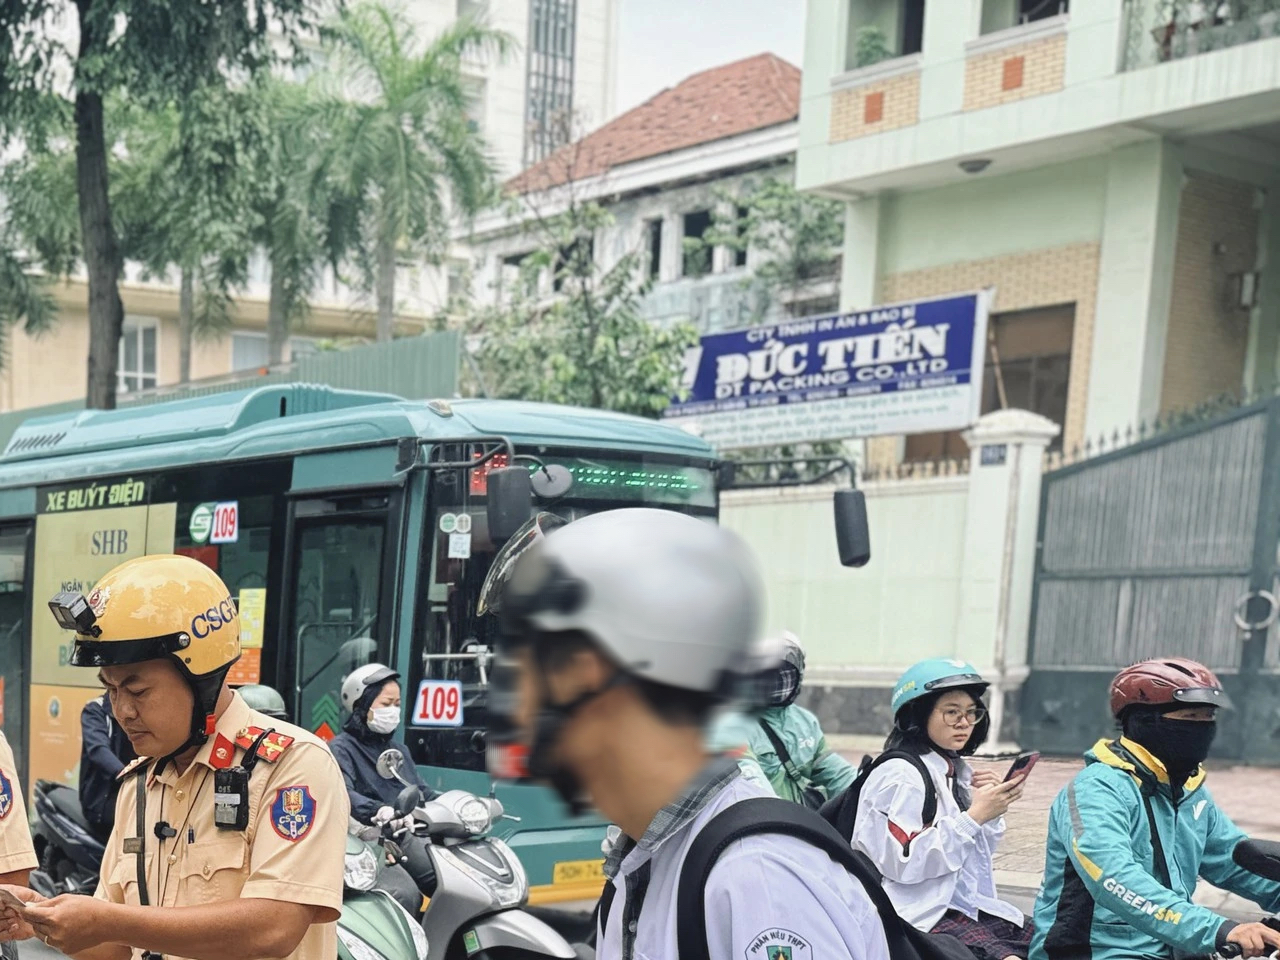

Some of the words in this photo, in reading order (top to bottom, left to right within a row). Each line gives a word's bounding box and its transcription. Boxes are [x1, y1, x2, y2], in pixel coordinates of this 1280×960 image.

[715, 338, 809, 385] ĐỨC
[818, 318, 950, 372] TIẾN
[715, 381, 744, 399] DT
[749, 370, 850, 394] PACKING
[45, 491, 66, 512] XE
[66, 482, 108, 509] BUÝT
[213, 507, 236, 538] 109
[91, 529, 128, 556] SHB
[419, 687, 459, 720] 109
[787, 935, 807, 950] THPT
